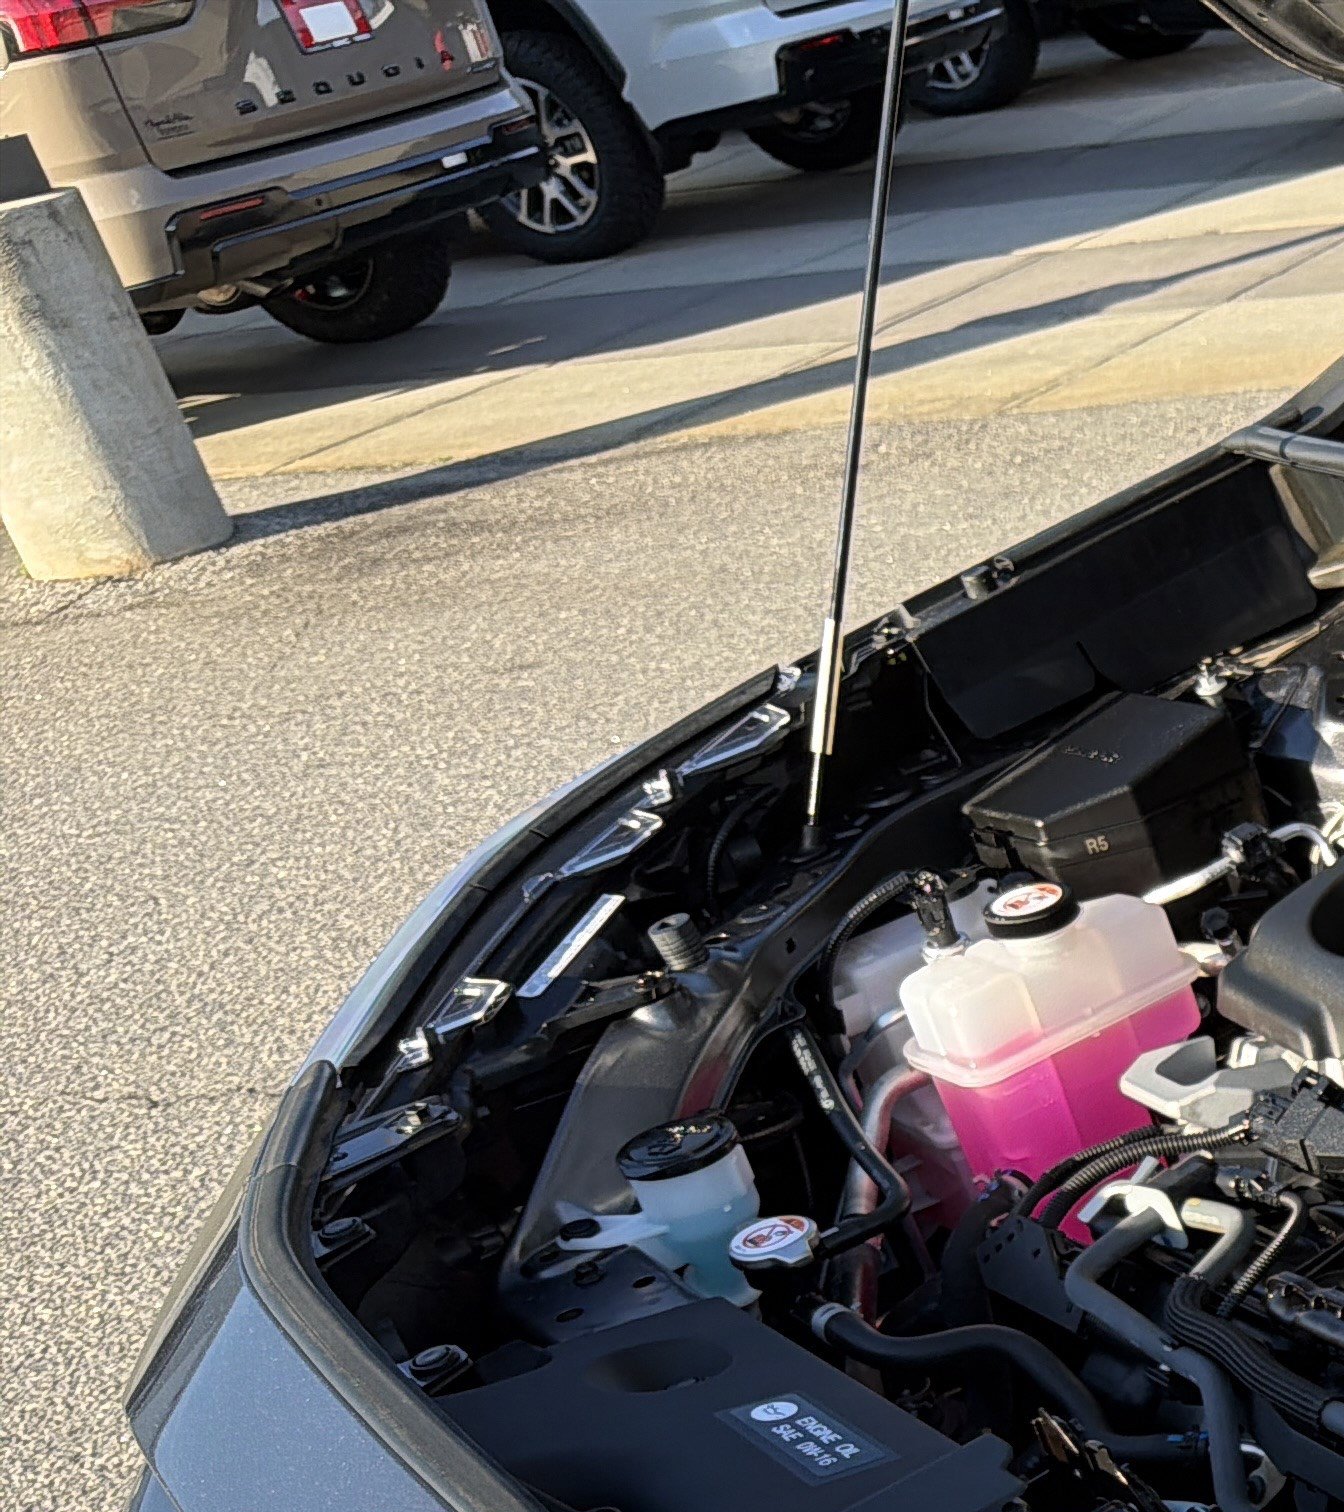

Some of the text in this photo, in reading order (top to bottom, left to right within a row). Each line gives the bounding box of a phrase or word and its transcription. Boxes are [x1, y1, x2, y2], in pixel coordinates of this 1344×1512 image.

[235, 50, 454, 116] SEQUOIA
[1085, 835, 1110, 855] R5
[771, 1423, 804, 1442] SAE
[795, 1416, 861, 1459] ENGINE OIL
